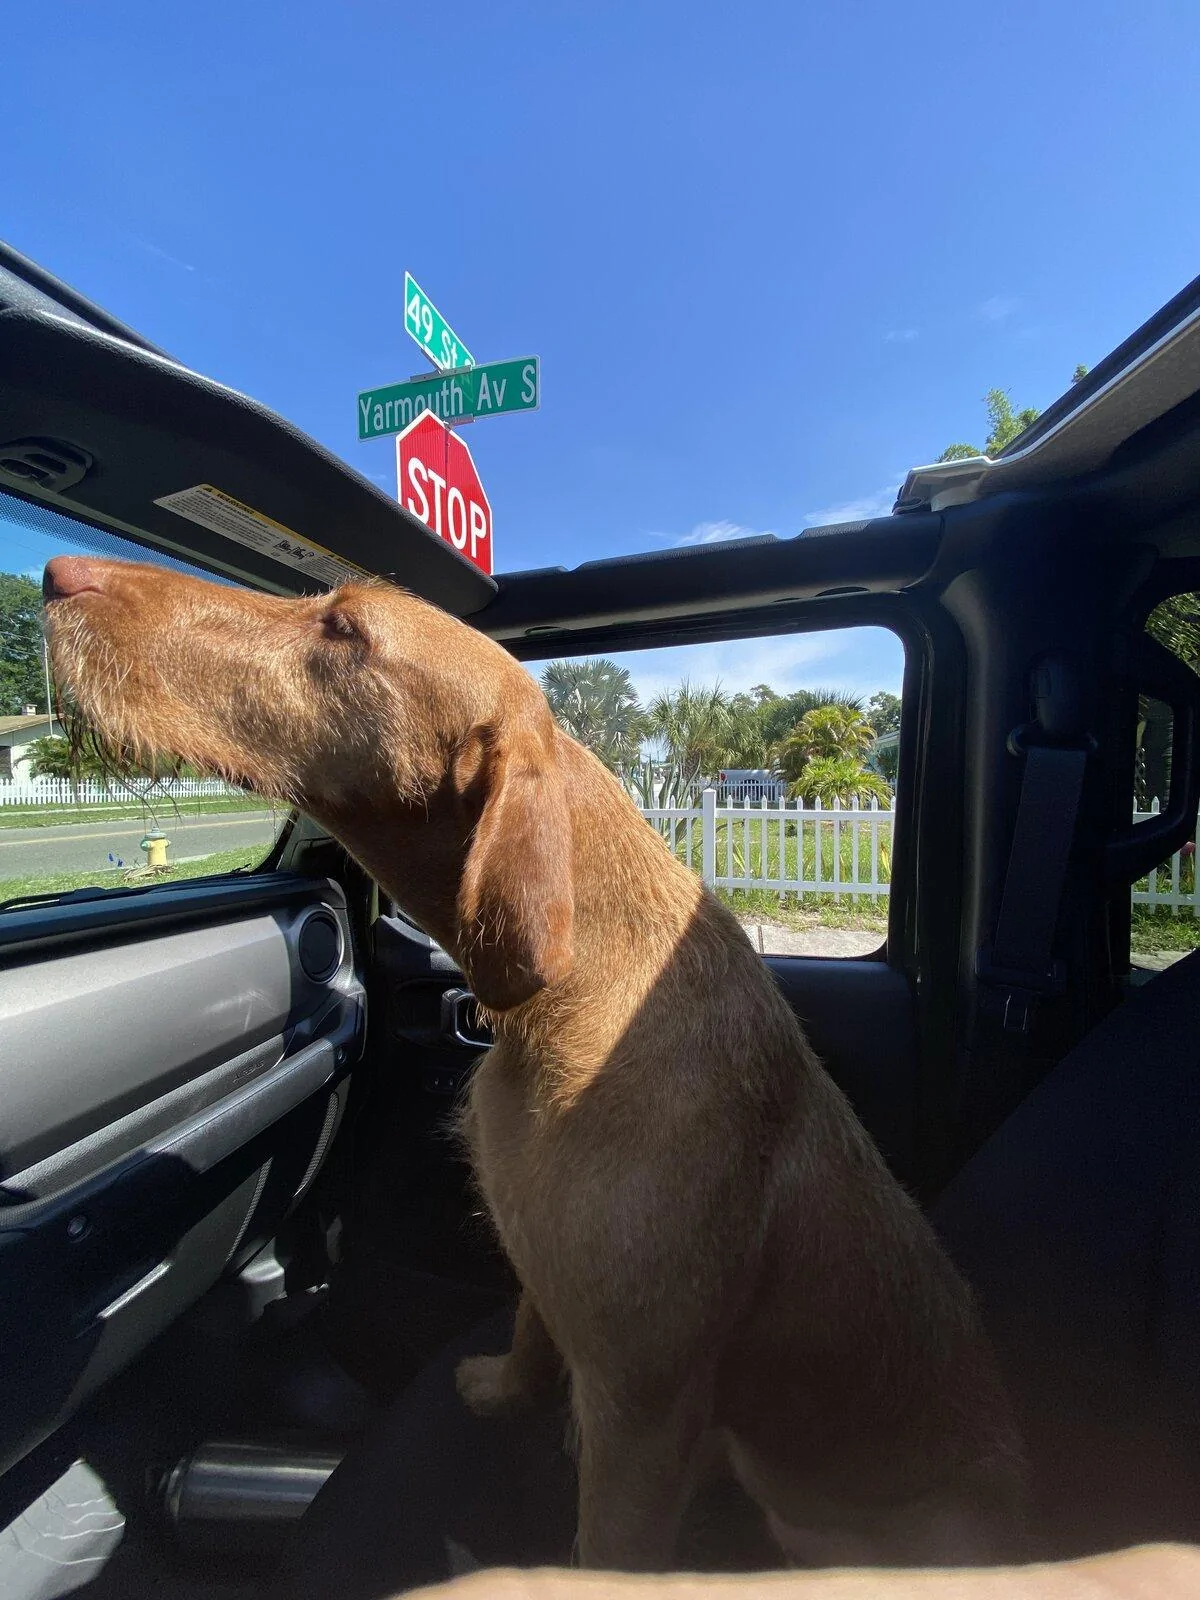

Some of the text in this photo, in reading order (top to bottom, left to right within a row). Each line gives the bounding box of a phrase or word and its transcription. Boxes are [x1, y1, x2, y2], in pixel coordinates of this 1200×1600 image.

[407, 293, 458, 369] 49 St
[360, 364, 536, 433] Yarmouth Av S
[407, 457, 487, 559] STOP
